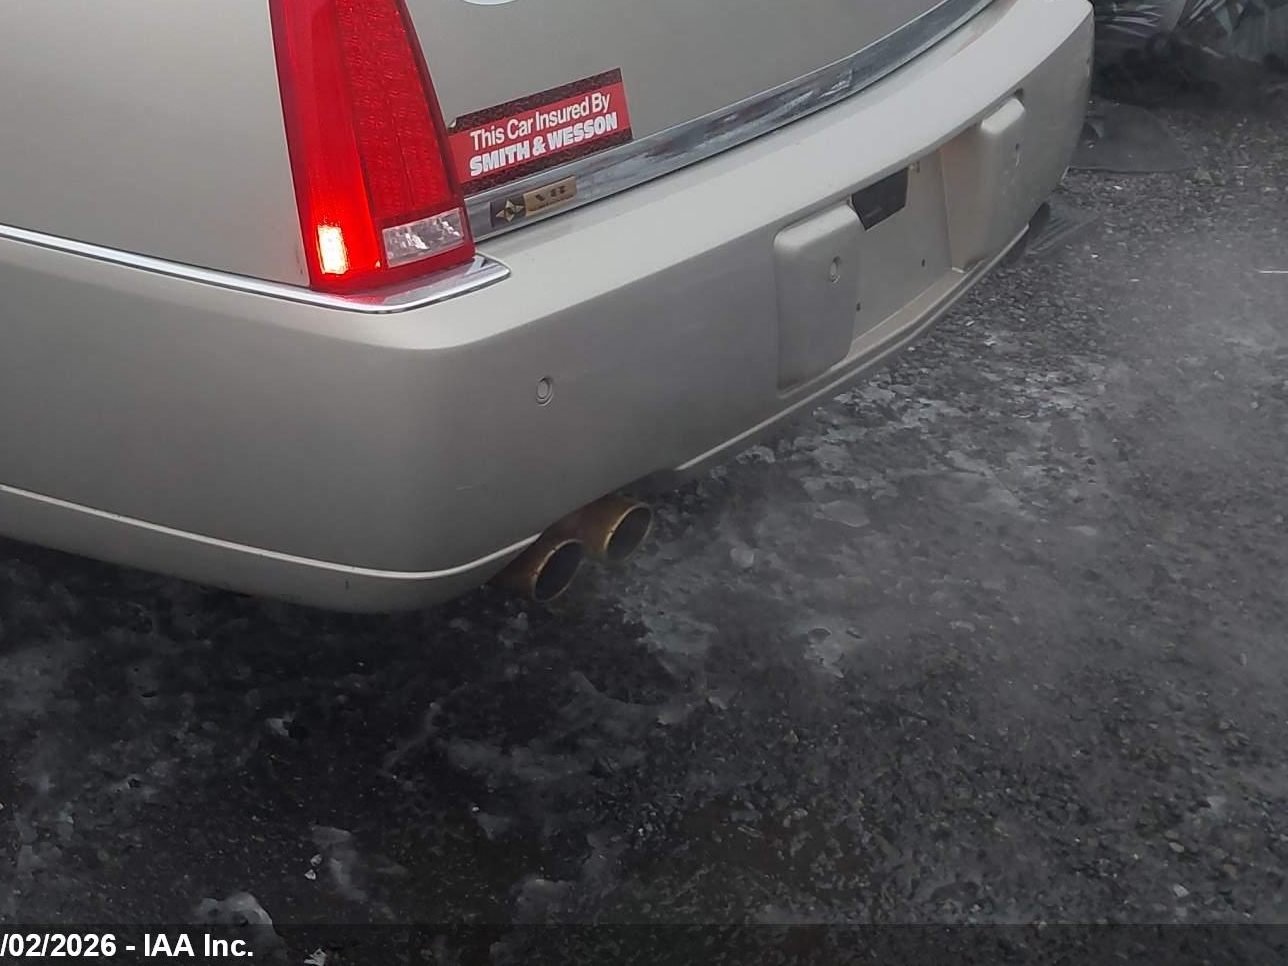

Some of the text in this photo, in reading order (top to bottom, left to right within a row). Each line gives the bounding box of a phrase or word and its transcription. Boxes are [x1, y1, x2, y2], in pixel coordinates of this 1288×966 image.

[469, 111, 618, 176] SMITH & WESSON
[470, 92, 610, 151] This Car Insured By
